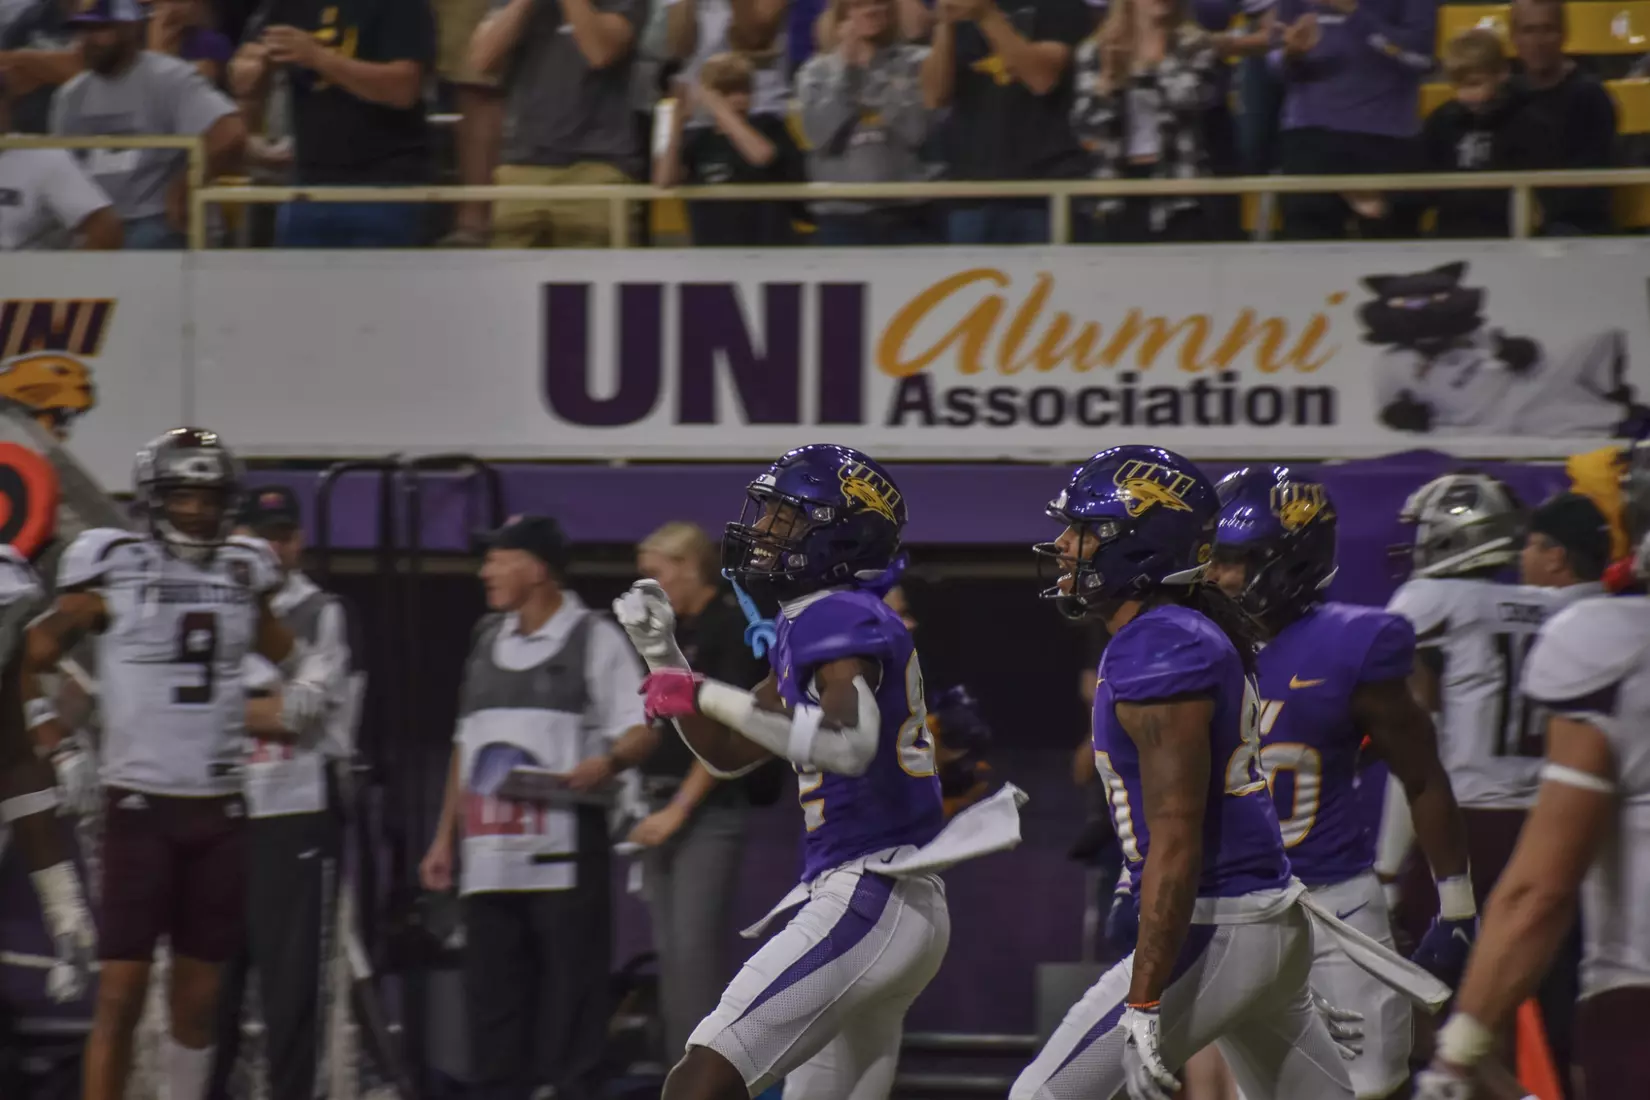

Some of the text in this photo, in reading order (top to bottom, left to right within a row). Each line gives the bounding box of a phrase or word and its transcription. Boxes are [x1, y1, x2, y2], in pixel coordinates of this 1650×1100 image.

[541, 281, 868, 428] UNI
[874, 267, 1346, 378] Alumni
[884, 370, 1338, 427] Association
[172, 611, 218, 704] 9
